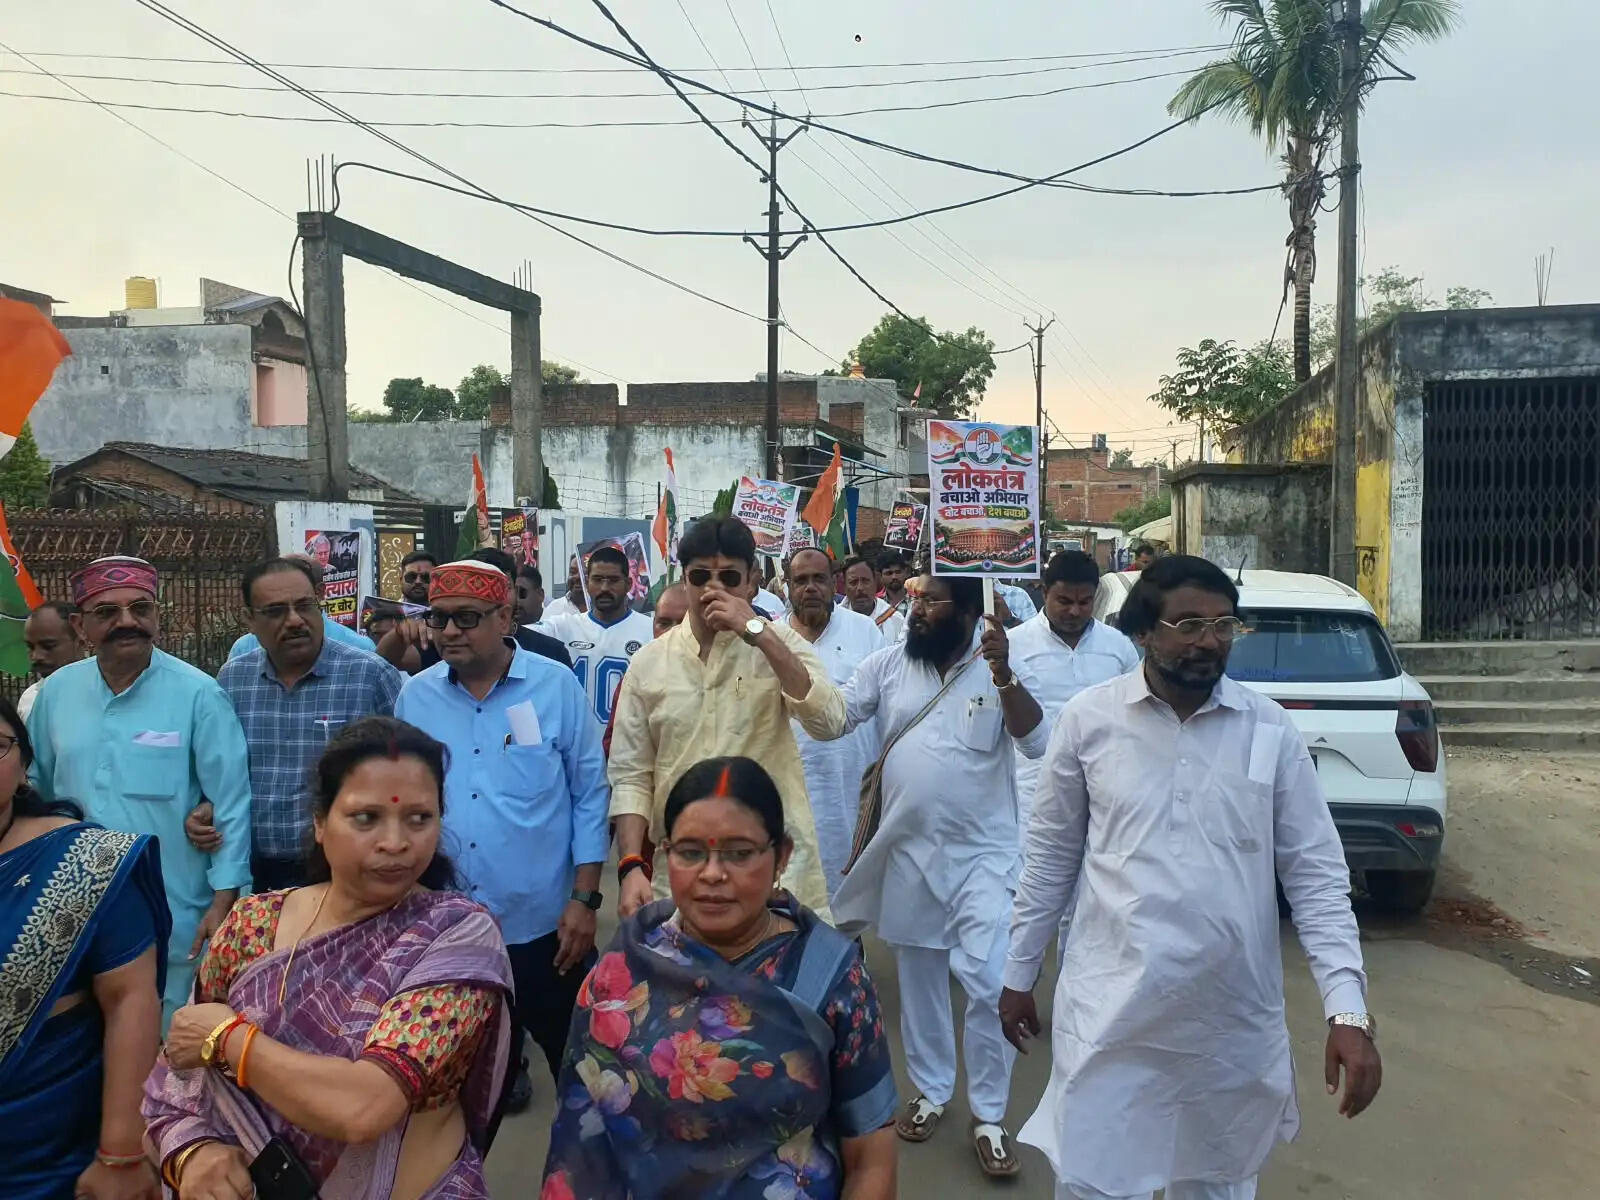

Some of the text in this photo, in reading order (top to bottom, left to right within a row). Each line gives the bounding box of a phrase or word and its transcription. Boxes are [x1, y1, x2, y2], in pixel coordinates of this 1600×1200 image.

[941, 462, 1026, 490] लोकतंत्र
[940, 488, 1029, 505] बचाओ अभियान
[741, 498, 788, 518] लोकतंत्र
[325, 579, 358, 600] त्यारा
